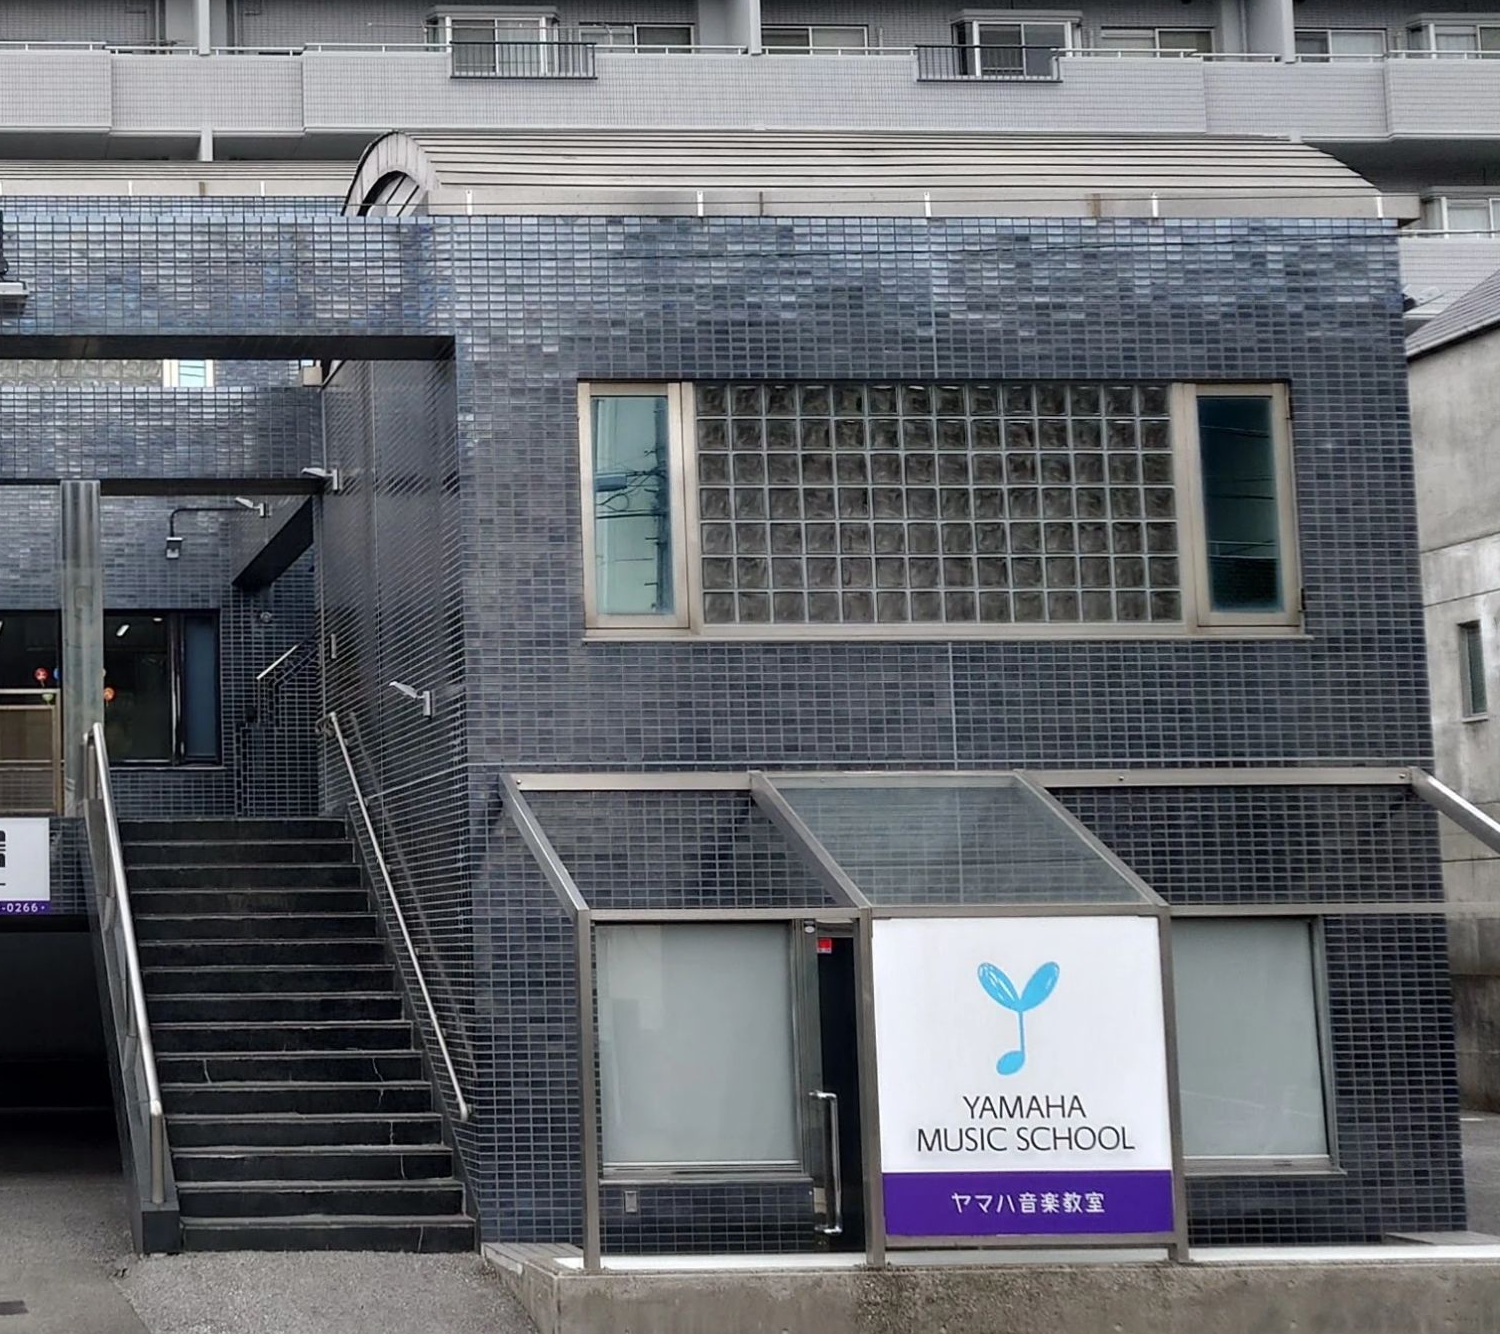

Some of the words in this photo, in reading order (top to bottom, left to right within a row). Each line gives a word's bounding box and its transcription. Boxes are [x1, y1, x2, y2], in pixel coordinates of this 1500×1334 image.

[963, 1095, 1087, 1120] YAMAHA
[917, 1127, 1008, 1153] MUSIC
[1016, 1126, 1136, 1152] SCHOOL
[951, 1191, 1105, 1214] ヤマハ音楽教室
